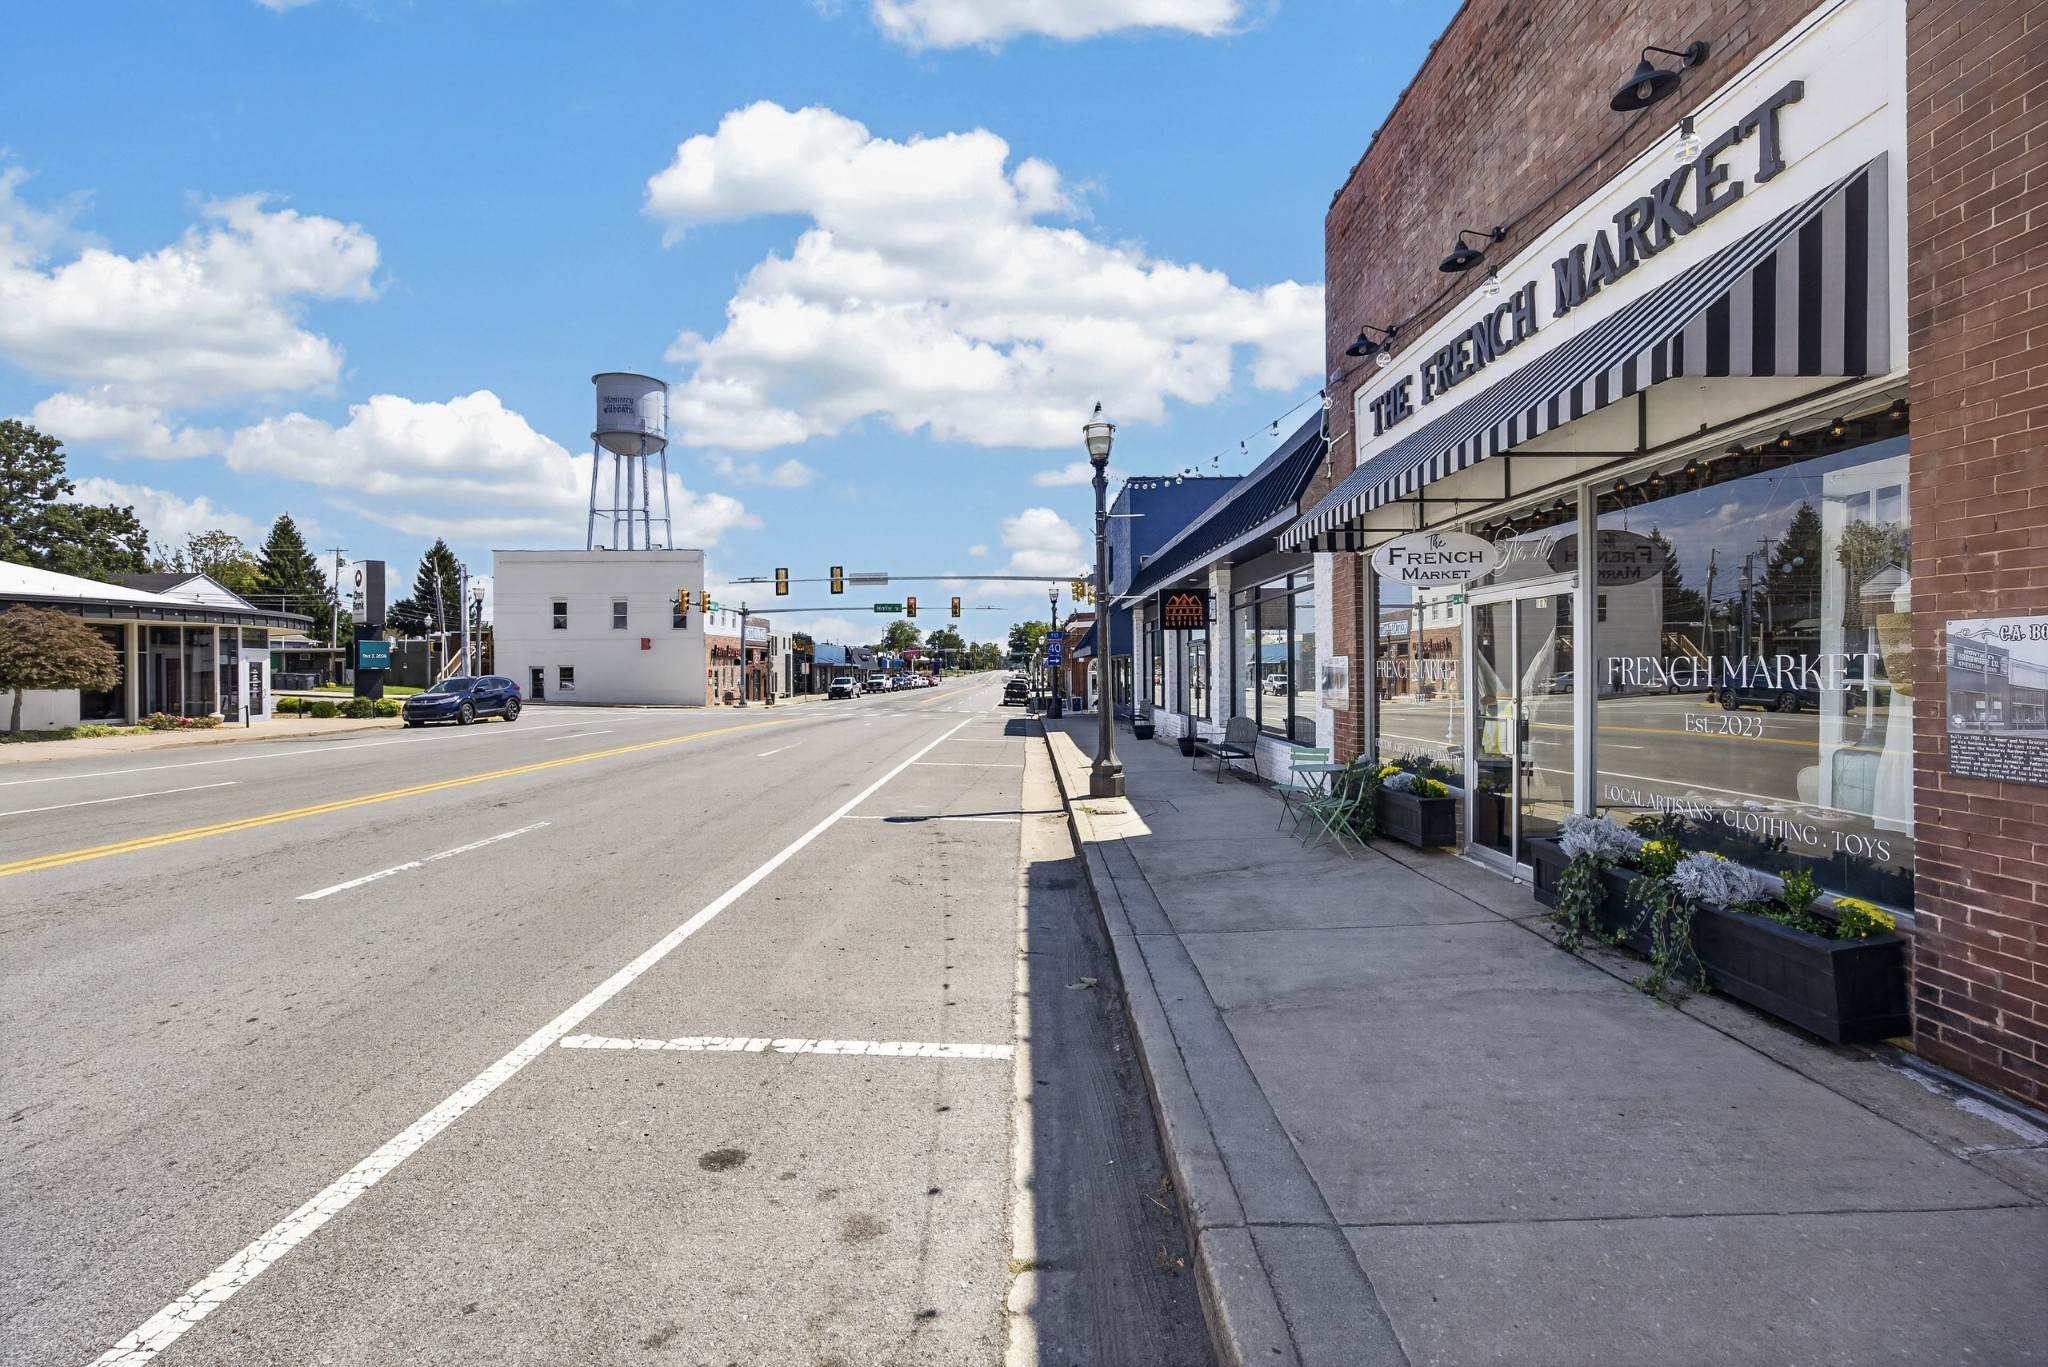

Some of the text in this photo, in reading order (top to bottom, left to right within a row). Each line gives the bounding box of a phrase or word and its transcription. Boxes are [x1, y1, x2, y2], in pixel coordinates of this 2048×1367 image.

[1369, 80, 1805, 437] THE FRENCH MARKET
[1425, 533, 1446, 551] The
[1388, 547, 1483, 566] FRENCH
[1402, 567, 1471, 580] MARKET
[1048, 644, 1061, 653] 40
[1376, 659, 1459, 680] FRENCH MARKET
[1607, 653, 1880, 692] FRENCH MARKET
[1684, 712, 1763, 740] Est. 2023
[1604, 784, 1891, 862] LOCAL ARTISANS CLOTHING TOYS
